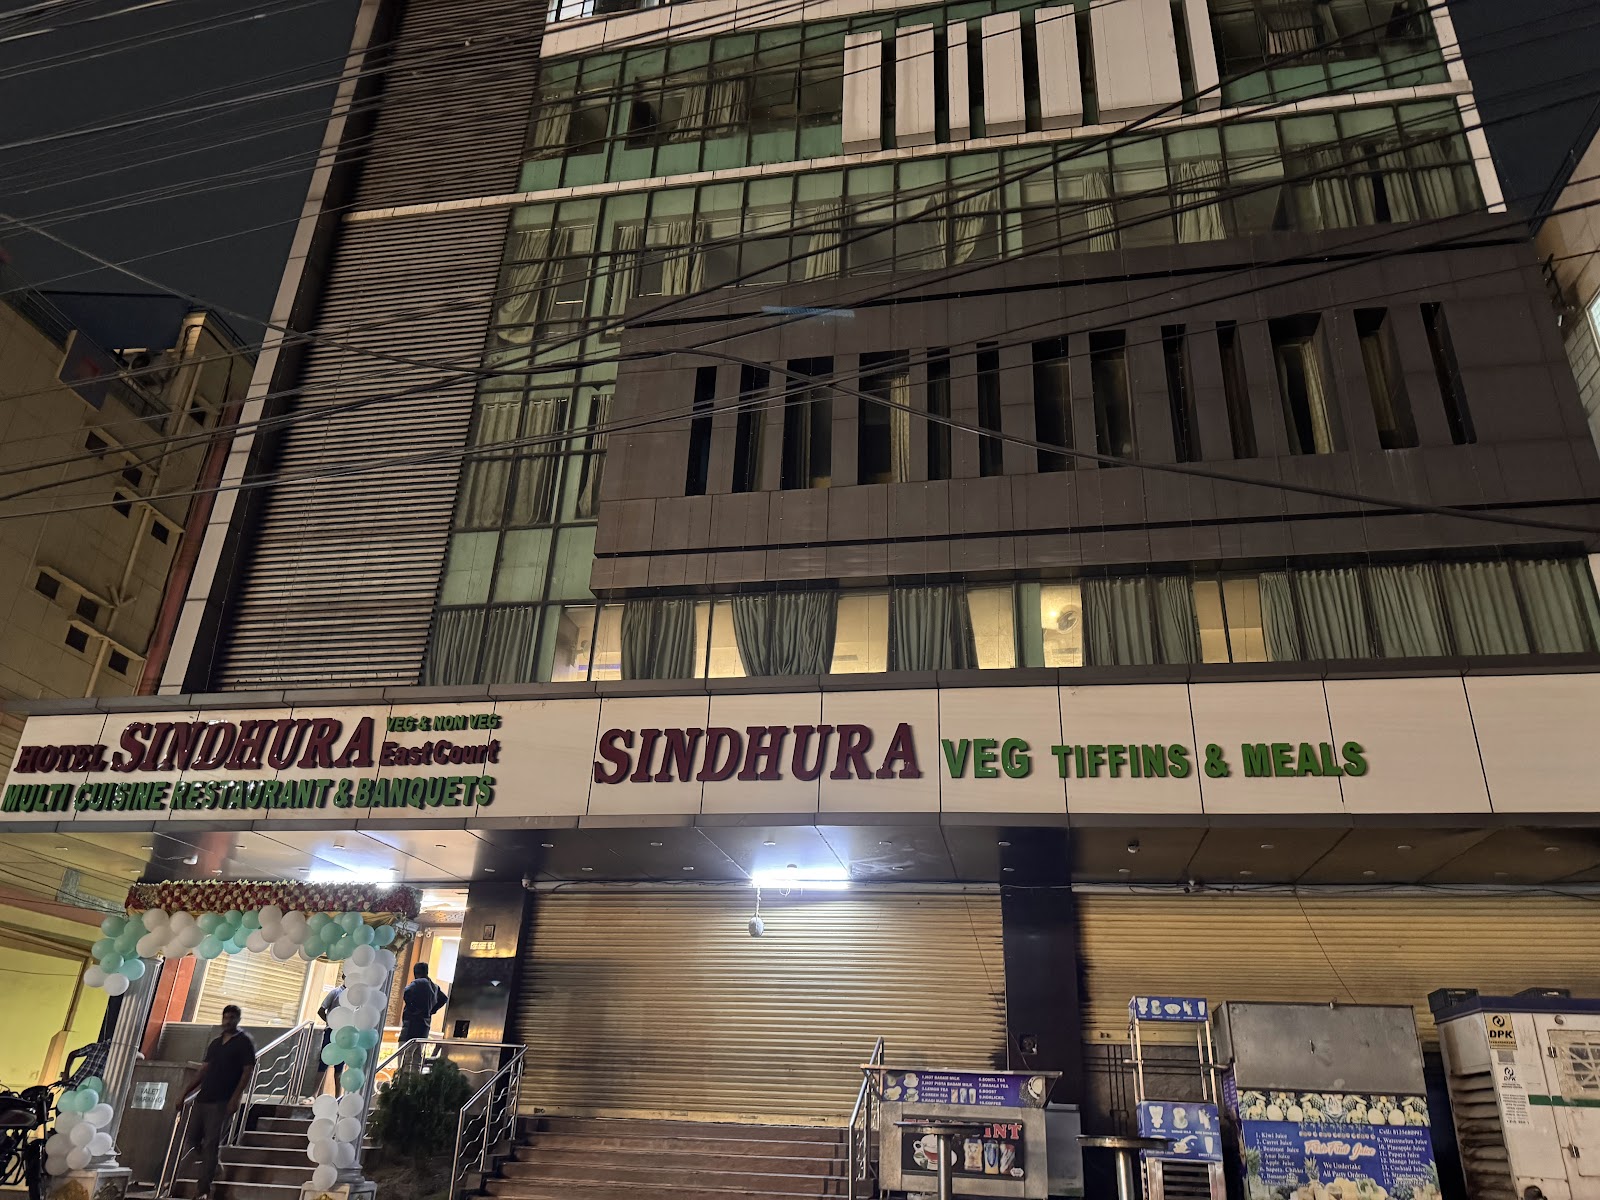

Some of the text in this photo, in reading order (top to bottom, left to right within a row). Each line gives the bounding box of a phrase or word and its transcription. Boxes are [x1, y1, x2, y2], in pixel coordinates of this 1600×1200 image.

[387, 714, 502, 732] VEG & NON VEG
[14, 716, 375, 773] HOTEL SINDHURA
[594, 722, 1368, 785] SINDHURA VEG TIFFINS & MEALS
[1, 775, 497, 812] MULTI CUISINE RESTAURANT & BANQUETS
[1490, 1030, 1513, 1038] DPK
